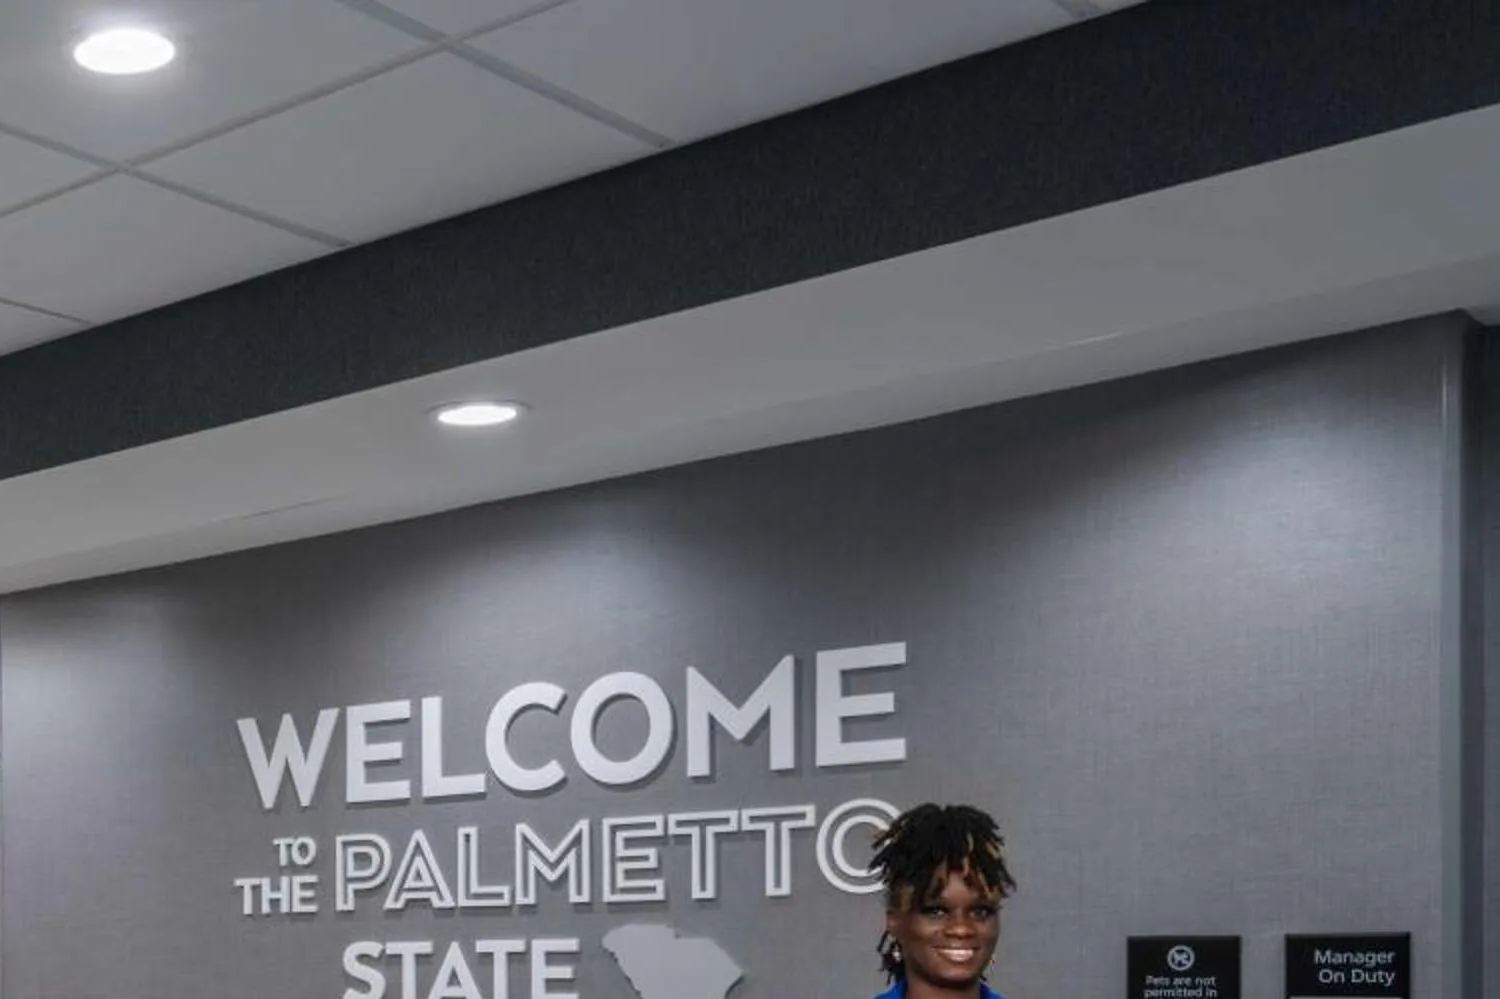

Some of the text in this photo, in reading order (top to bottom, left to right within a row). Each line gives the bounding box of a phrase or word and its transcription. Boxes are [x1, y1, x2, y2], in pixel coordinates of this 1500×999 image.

[237, 641, 906, 809] WELCOME
[273, 837, 317, 867] TO
[335, 798, 901, 912] PALMETTO
[234, 875, 318, 915] THE
[1314, 949, 1396, 968] Manager
[1173, 977, 1192, 987] are
[1196, 976, 1217, 987] not
[1319, 969, 1396, 987] On Duty
[1143, 988, 1218, 999] permitted in
